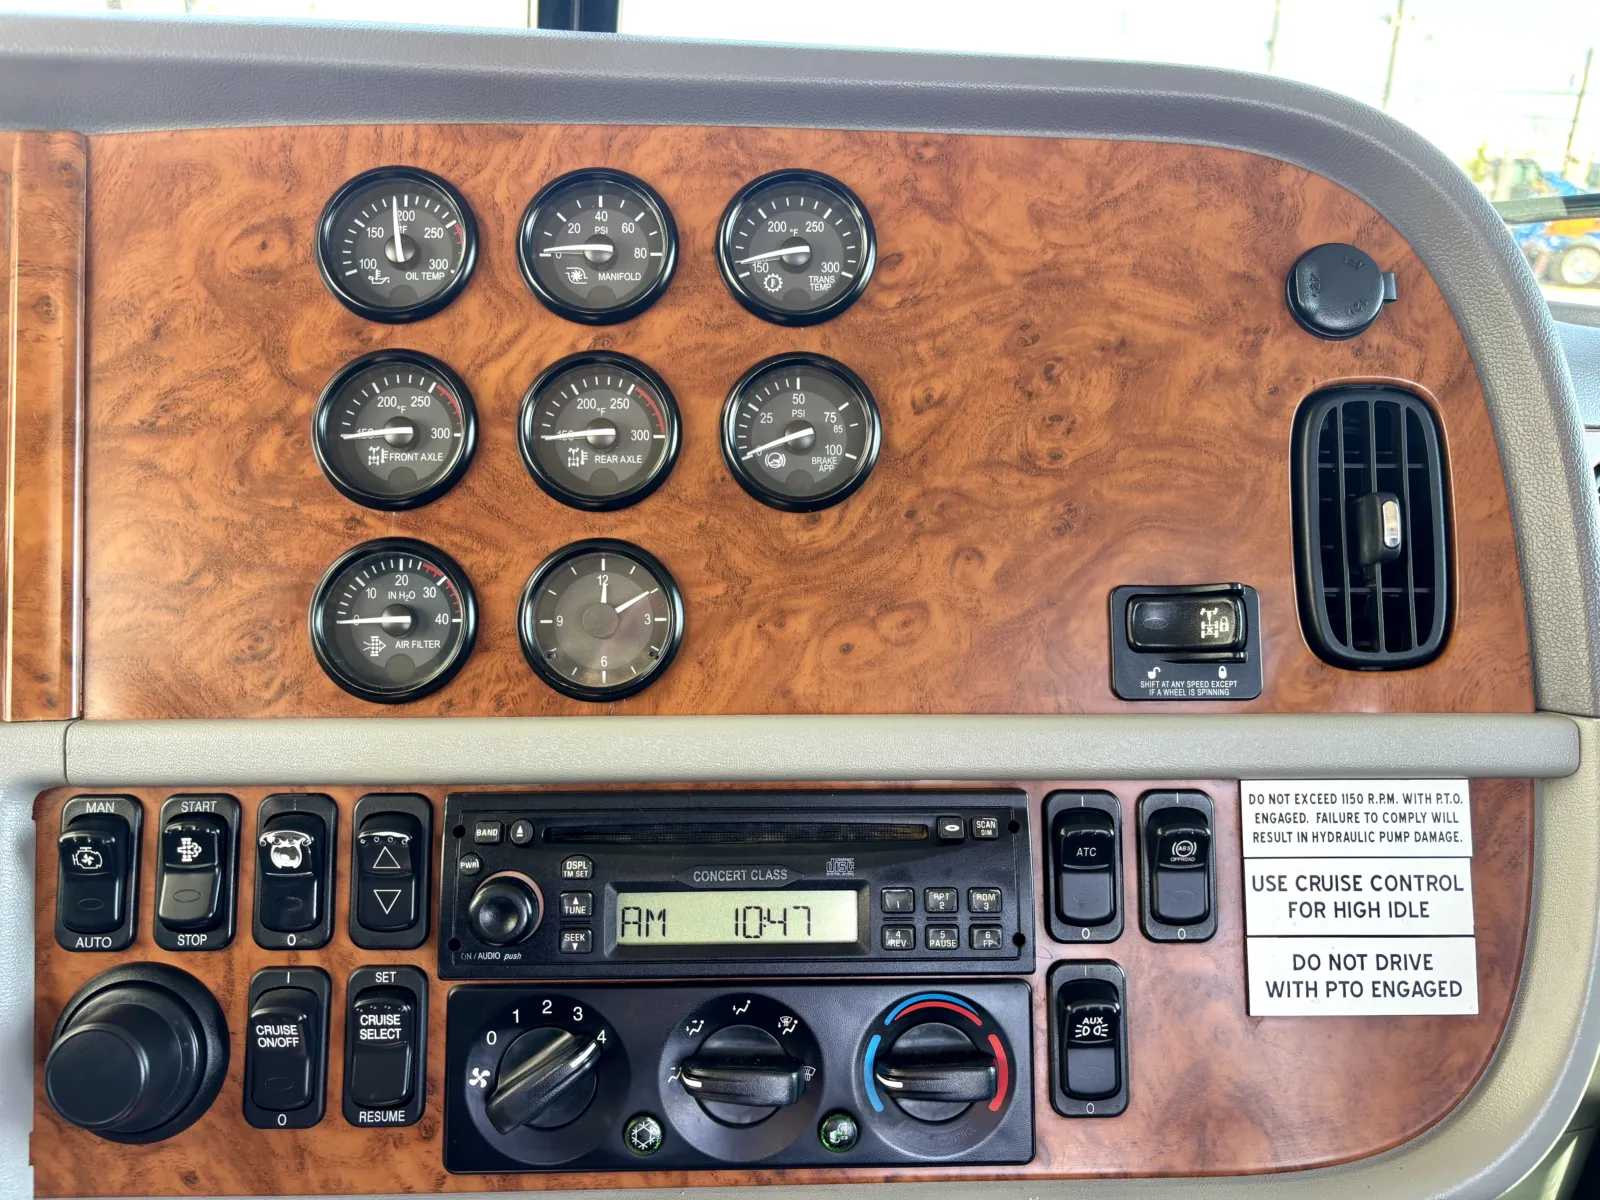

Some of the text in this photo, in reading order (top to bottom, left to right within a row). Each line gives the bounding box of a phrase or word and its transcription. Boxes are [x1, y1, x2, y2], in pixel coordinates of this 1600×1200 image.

[397, 211, 416, 222] 200
[594, 211, 608, 222] 40
[366, 227, 384, 238] 150
[568, 223, 581, 234] 20
[621, 223, 635, 234] 60
[768, 221, 787, 233] 200
[805, 221, 824, 233] 250
[424, 228, 444, 239] 250
[634, 248, 647, 259] 80
[359, 259, 377, 270] 100
[429, 259, 448, 270] 300
[752, 262, 769, 273] 150
[821, 262, 840, 273] 300
[405, 272, 445, 280] OIL TEMP
[598, 273, 642, 281] MANIFOLD
[809, 276, 835, 284] TRANS
[377, 396, 397, 408] 200
[410, 396, 431, 408] 250
[576, 398, 596, 409] 200
[610, 398, 630, 409] 250
[792, 393, 805, 405] 50
[760, 413, 773, 424] 25
[792, 410, 806, 418] PSI
[824, 412, 837, 423] 75
[431, 428, 450, 439] 300
[834, 425, 843, 434] 85
[631, 430, 650, 441] 300
[825, 445, 843, 456] 100
[389, 453, 444, 461] FRONT AXLE
[594, 455, 643, 464] REAR AXLE
[811, 457, 837, 465] BRAKE
[395, 575, 409, 586] 20
[597, 575, 609, 586] 12
[365, 588, 377, 599] 10
[423, 587, 437, 598] 30
[435, 613, 449, 625] 40
[556, 616, 564, 627] 9
[644, 614, 651, 625] 3
[395, 640, 441, 648] AIR FILTER
[601, 656, 608, 667] 6
[1140, 681, 1159, 689] SHIFT
[1171, 681, 1185, 689] ANY
[1187, 681, 1210, 689] SPEED
[1211, 680, 1238, 689] EXCEPT
[1249, 793, 1463, 805] DO NOT EXCEED 1150 R.P.M. WITH P.T.O.
[86, 802, 115, 813] MAN
[181, 801, 217, 812] START
[1255, 812, 1459, 824] ENGAGED. FAILURE TO COMPLY WILL
[976, 821, 996, 829] SCAN
[1252, 831, 1463, 843] RESULT IN HYDRAULIC PUMP DAMAGE.
[1076, 847, 1097, 857] ATC
[566, 861, 587, 870] DSPL
[693, 869, 788, 882] CONCERT CLASS
[1252, 874, 1465, 892] USE CRUISE CONTROL
[564, 907, 586, 915] TUNE
[984, 902, 989, 910] 3
[1288, 901, 1430, 919] FOR HIGH IDLE
[621, 906, 811, 939] AM 10:47
[75, 937, 112, 948] AUTO
[177, 934, 208, 946] STOP
[564, 934, 586, 942] SEEK
[503, 953, 522, 961] push
[1292, 954, 1434, 971] DO NOT DRIVE
[375, 972, 397, 983] SET
[1265, 980, 1463, 998] WITH PTO ENGAGED
[542, 1000, 553, 1014] 2
[512, 1009, 519, 1023] 1
[573, 1007, 583, 1021] 3
[360, 1015, 401, 1025] CRUISE
[1082, 1017, 1104, 1025] AUX
[256, 1025, 298, 1035] CRUISE
[359, 1028, 402, 1040] SELECT
[257, 1037, 299, 1048] ON/OFF
[486, 1030, 497, 1046] 0
[597, 1030, 607, 1044] 4
[359, 1111, 405, 1123] RESUME
